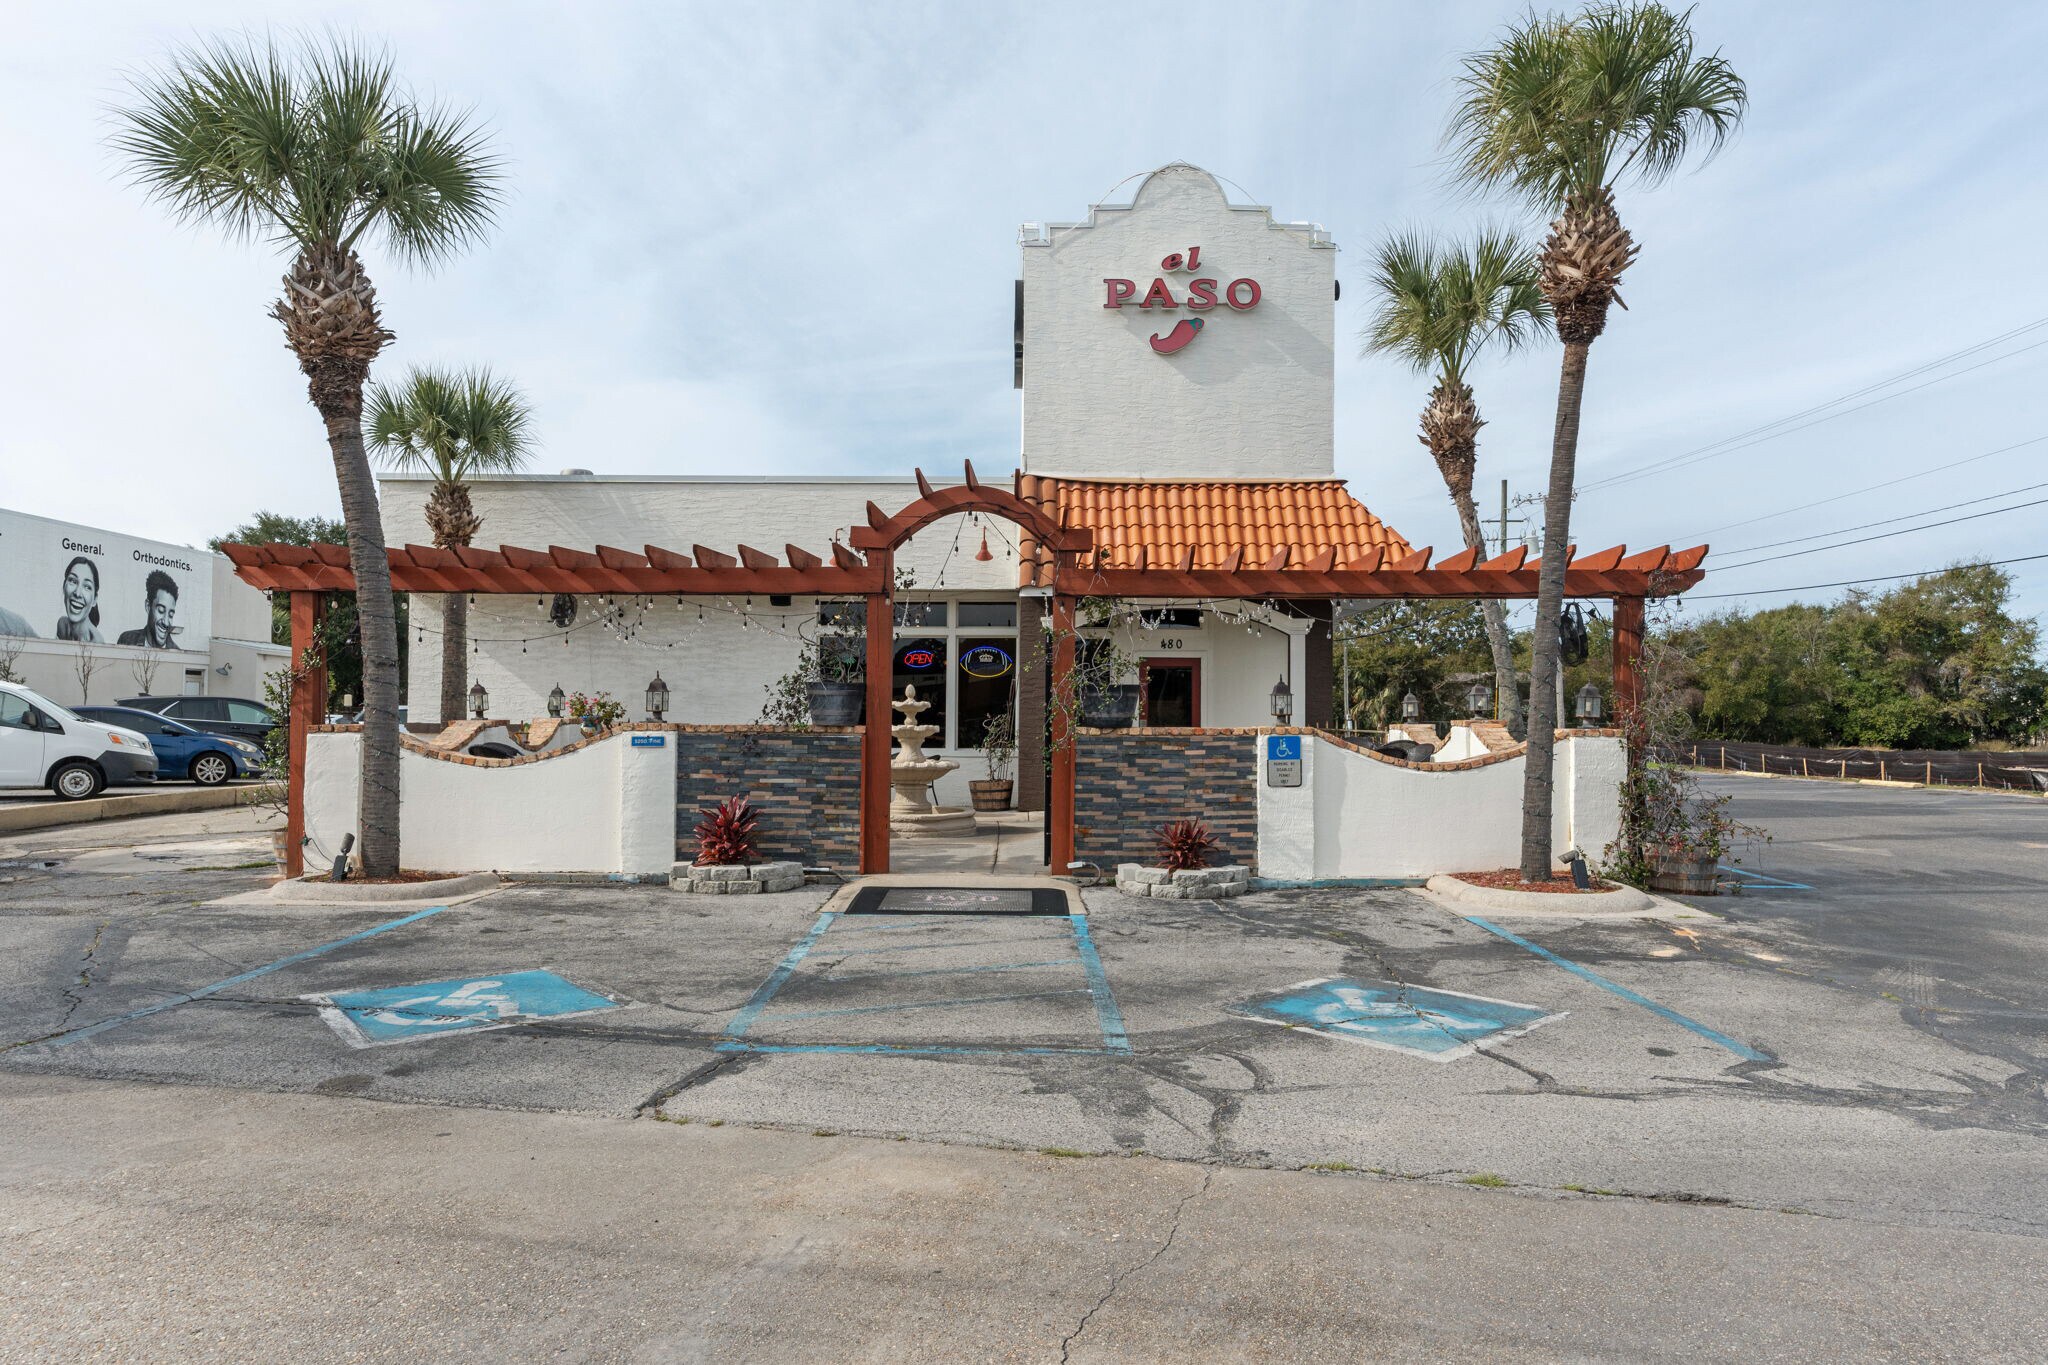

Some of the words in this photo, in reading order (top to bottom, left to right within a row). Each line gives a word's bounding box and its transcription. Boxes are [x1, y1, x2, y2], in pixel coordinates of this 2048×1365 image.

[1161, 246, 1202, 272] el
[1103, 277, 1262, 310] PASO
[61, 537, 105, 556] General.
[132, 550, 193, 572] Orthodontics.
[1160, 638, 1183, 649] 480
[904, 653, 935, 665] OPEN
